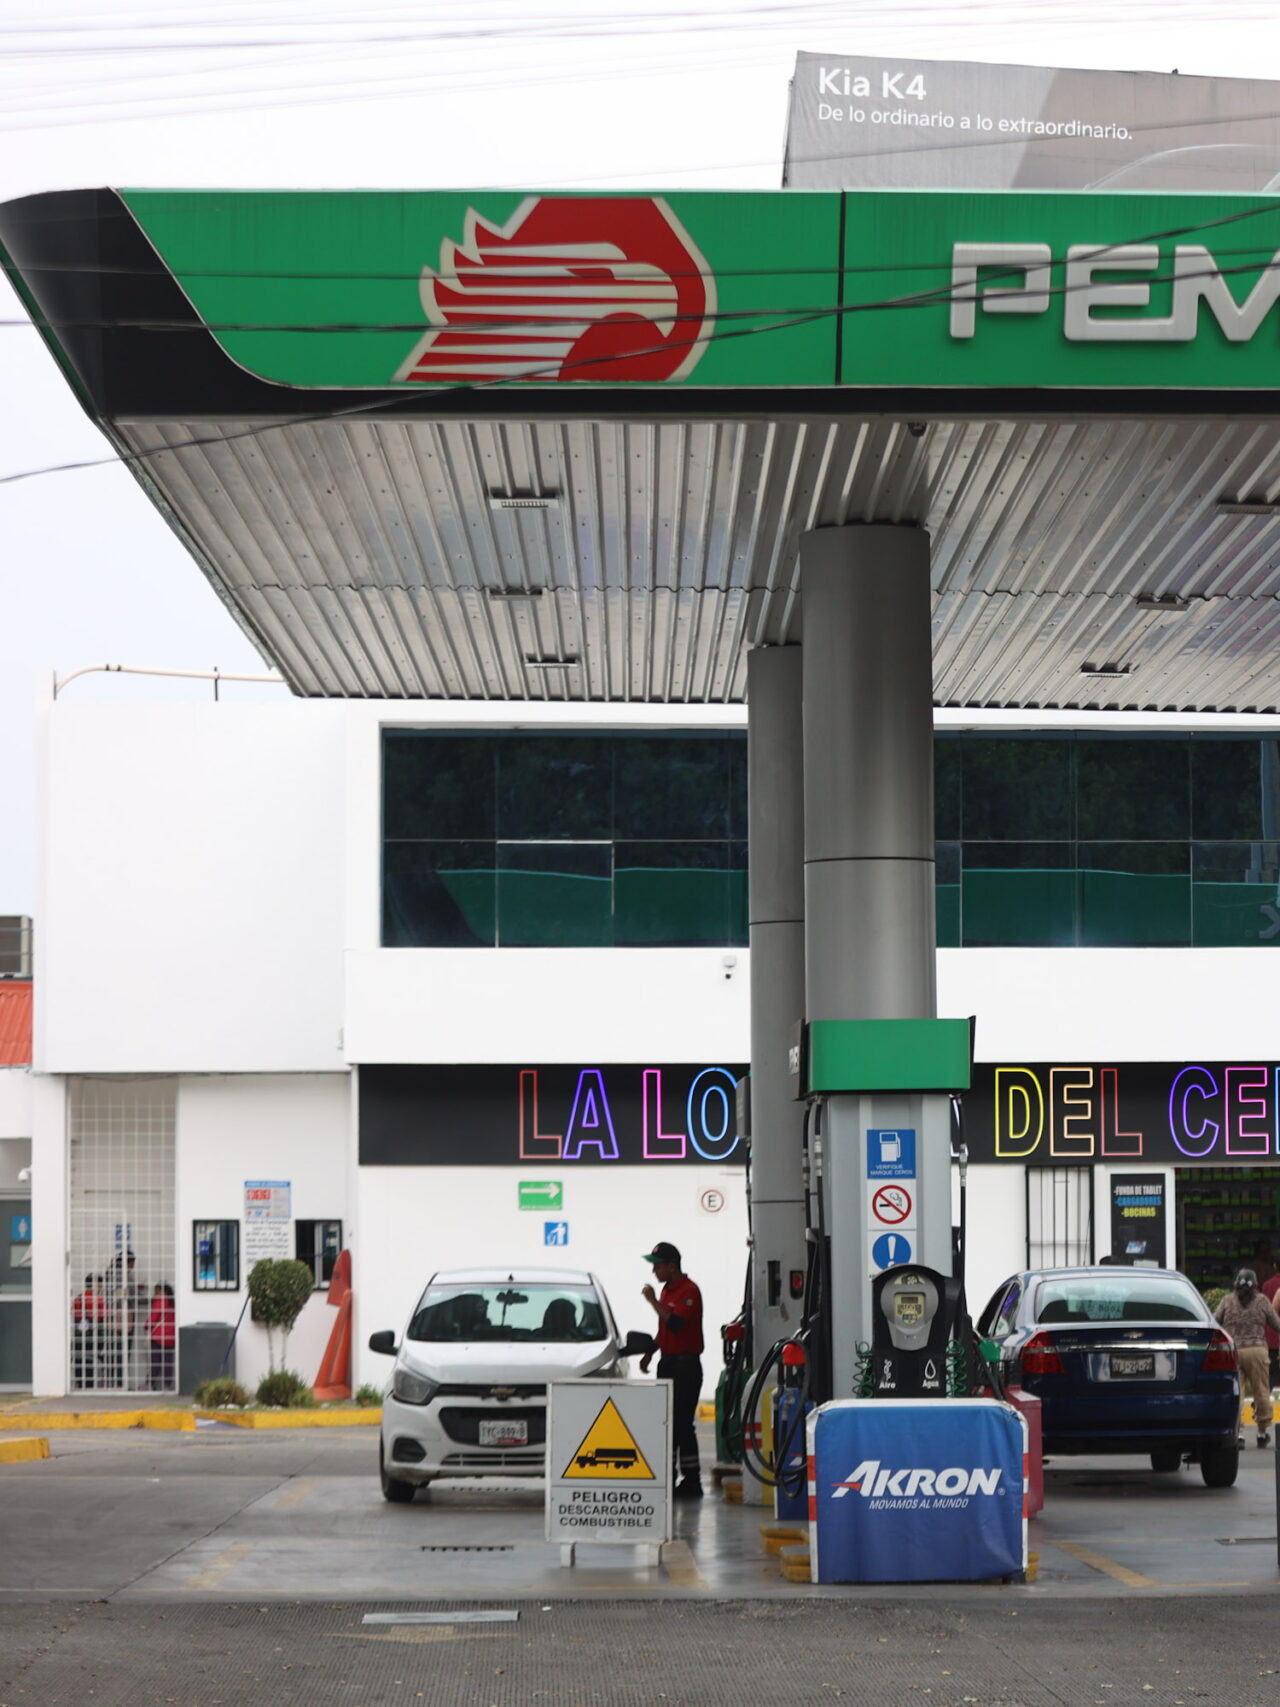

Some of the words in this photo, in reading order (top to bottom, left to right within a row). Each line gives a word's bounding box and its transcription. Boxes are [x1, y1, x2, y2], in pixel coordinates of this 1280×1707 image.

[818, 67, 871, 97] Kia
[882, 71, 927, 100] K4
[818, 104, 843, 121] De
[849, 106, 865, 123] lo
[871, 107, 954, 129] ordinario
[960, 117, 971, 130] a
[977, 114, 993, 131] lo
[999, 117, 1133, 140] extraordinario.
[519, 1068, 620, 1160] LA
[995, 1067, 1143, 1157] DEL
[879, 1381, 896, 1389] Aire
[922, 1379, 940, 1389] Agua
[831, 1460, 1003, 1498] AKRON
[572, 1491, 642, 1504] PELIGRO
[869, 1498, 917, 1510] MOVAMOS
[918, 1498, 932, 1509] AL
[933, 1498, 969, 1509] MUNDO
[558, 1504, 655, 1517] DESCARGANDO
[560, 1517, 653, 1528] COMBUSTIBLE
